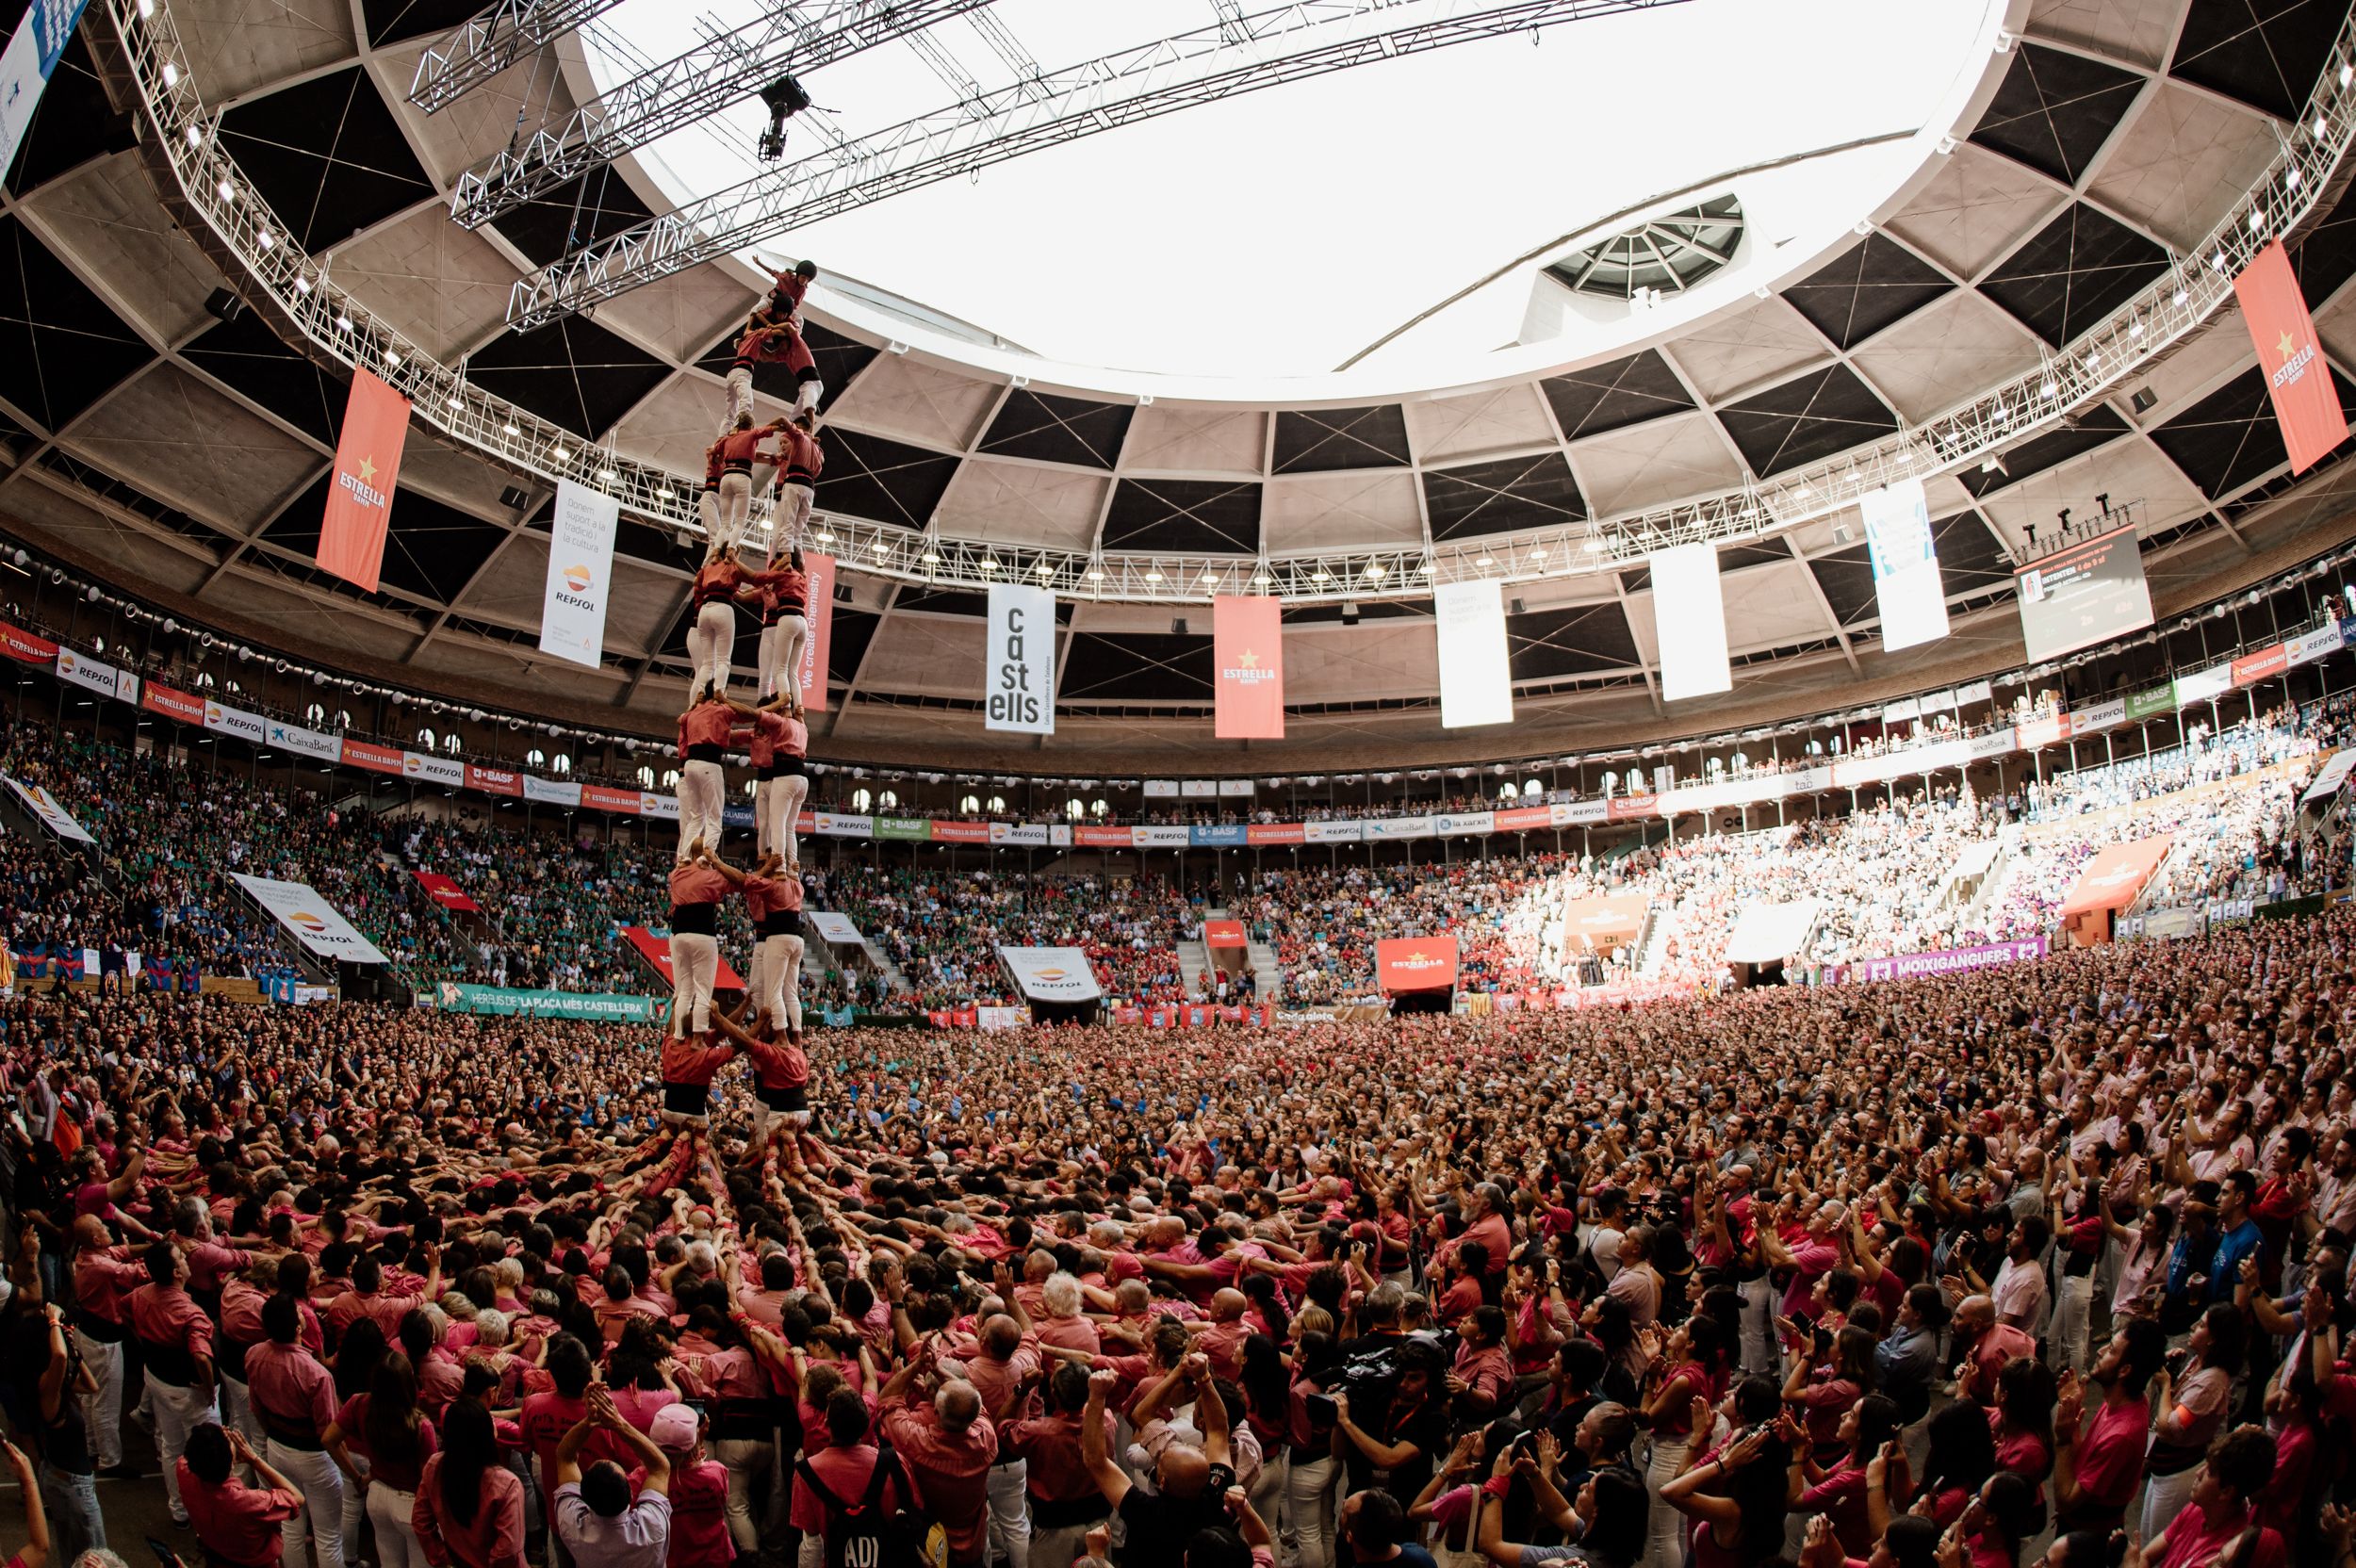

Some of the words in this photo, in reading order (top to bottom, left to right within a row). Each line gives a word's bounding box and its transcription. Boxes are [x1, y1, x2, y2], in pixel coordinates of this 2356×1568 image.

[2272, 345, 2315, 388] ESTRELLA
[339, 471, 385, 509] ESTRELLA
[352, 493, 369, 509] DAMM
[567, 498, 595, 514] Donem
[565, 510, 591, 529] suport
[598, 519, 607, 532] la
[564, 522, 594, 539] tradició
[563, 532, 571, 543] la
[571, 536, 599, 554] cultura
[556, 592, 596, 612] REPSOL
[808, 571, 822, 628] chemistry
[9, 637, 38, 658] ESTRELLA
[805, 630, 816, 667] create
[2307, 631, 2339, 651] REPSOL
[1223, 669, 1274, 678] ESTRELLA
[2241, 660, 2267, 675] ESTRELLA
[79, 667, 113, 687] REPSOL
[802, 669, 813, 689] We
[1001, 663, 1029, 692] st
[2147, 686, 2171, 702] BASF
[155, 694, 185, 711] ESTRELLA
[185, 705, 204, 717] DAMM
[990, 692, 1039, 724] ells
[2091, 708, 2124, 722] REPSOL
[226, 717, 262, 733] REPSOL
[287, 732, 334, 754] CaixaBank
[352, 750, 382, 763] ESTRELLA
[383, 757, 402, 767] DAMM
[426, 765, 463, 778] REPSOL
[487, 771, 514, 784] BASF
[592, 794, 619, 807] ESTRELLA
[619, 797, 639, 807] DAMM
[663, 803, 679, 812] REP
[724, 811, 753, 820] GUARDIA
[1572, 807, 1606, 816] REPSOL
[837, 822, 872, 830] REPSOL
[896, 820, 922, 830] BASF
[941, 828, 969, 837] ESTRELLA
[1212, 826, 1237, 836] BASF
[1385, 822, 1428, 833] CaixaBank
[302, 931, 354, 943] REPSOL
[1898, 948, 2011, 976] MOIXIGANGUERS
[505, 996, 516, 1006] DE
[563, 998, 582, 1010] MÉS
